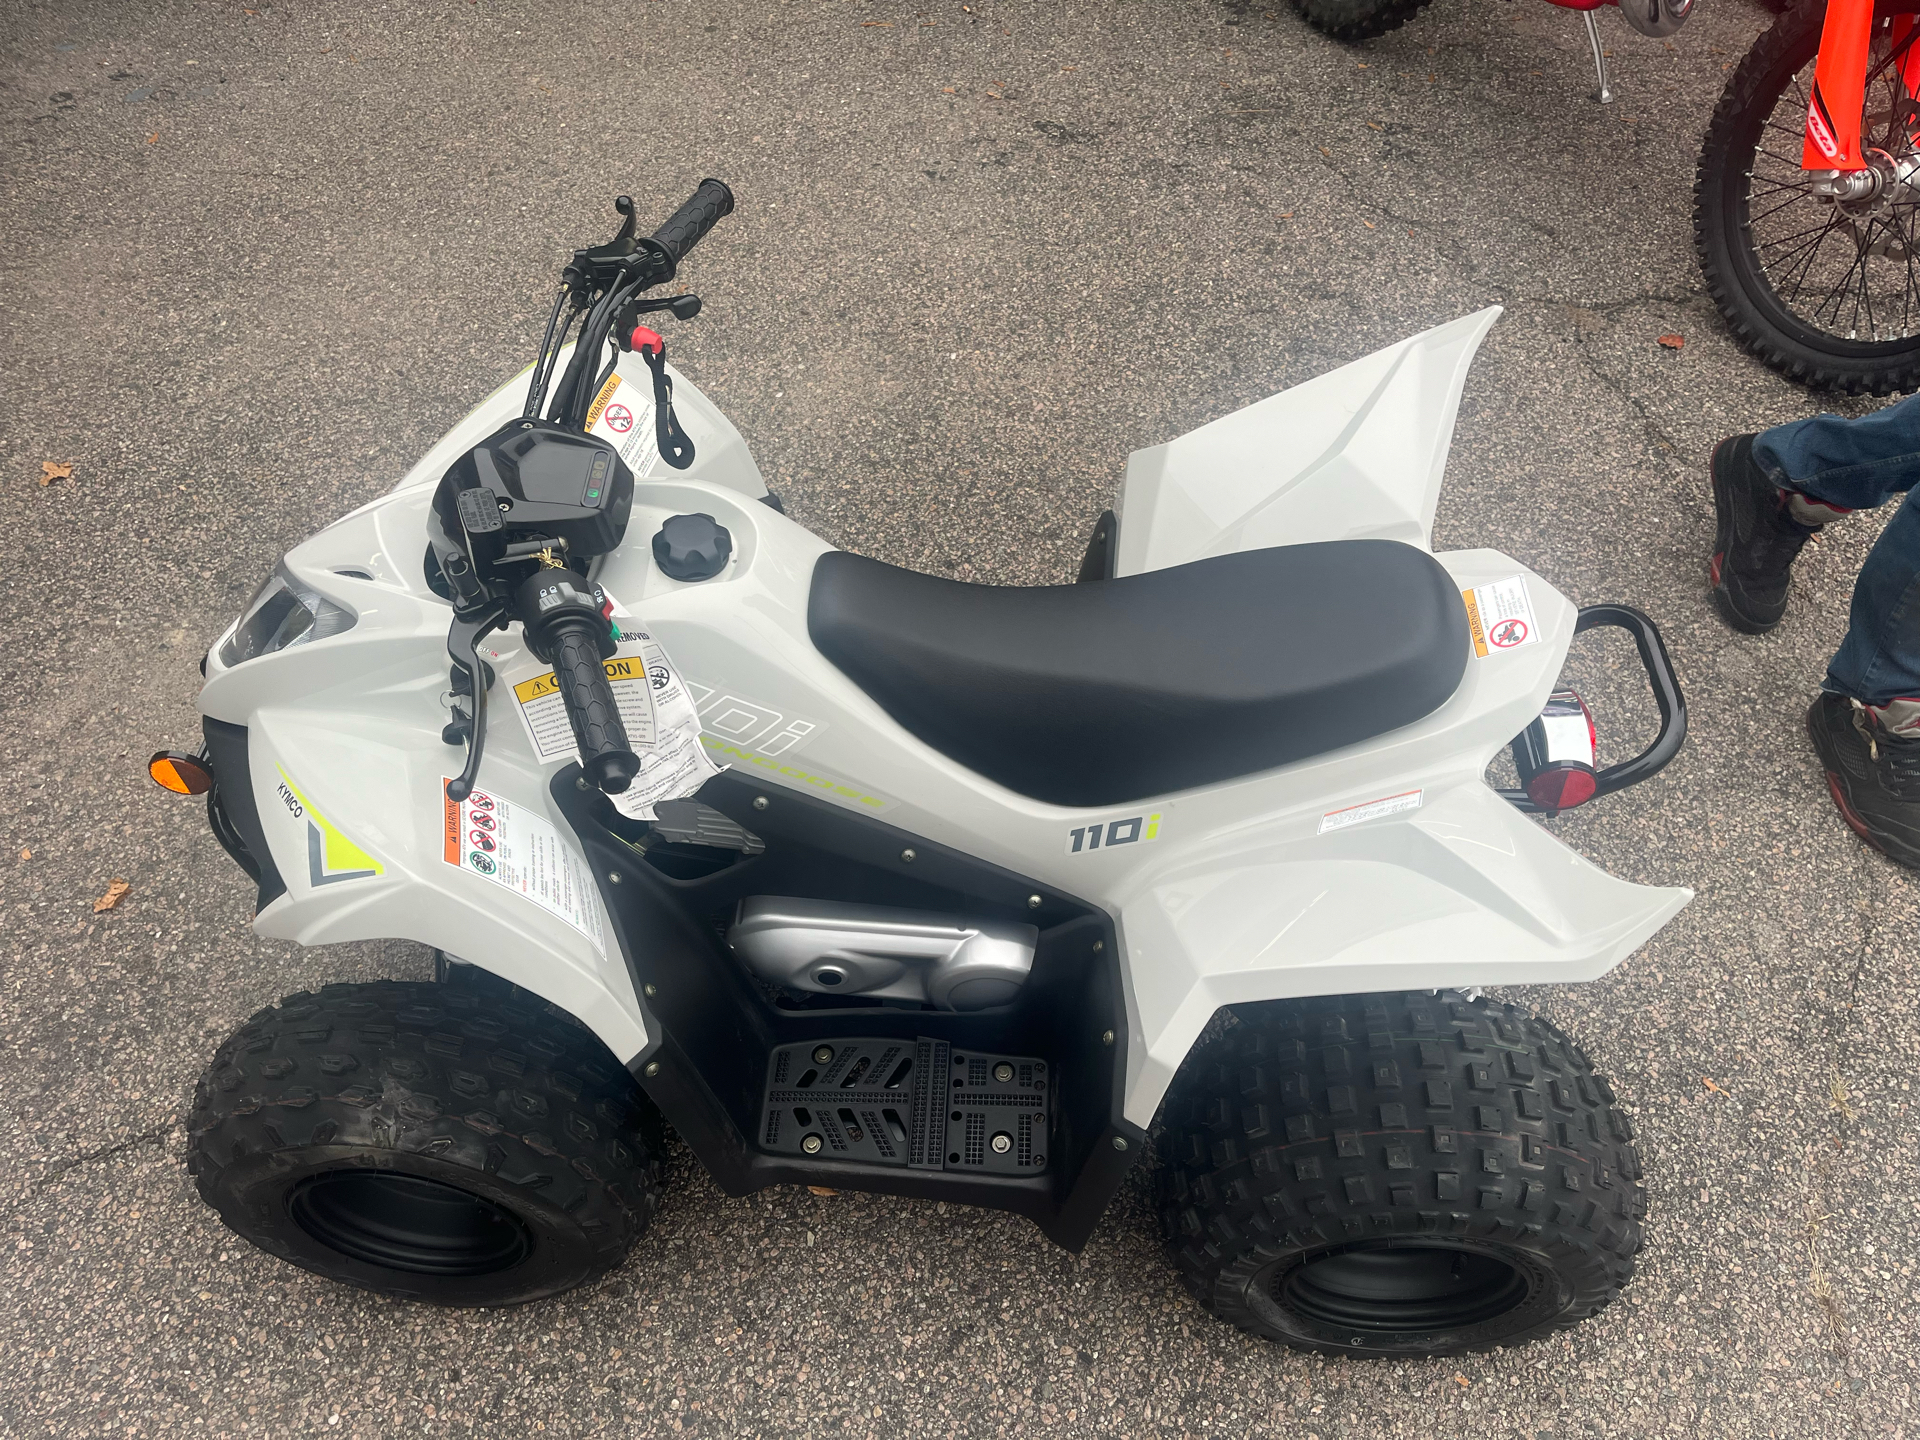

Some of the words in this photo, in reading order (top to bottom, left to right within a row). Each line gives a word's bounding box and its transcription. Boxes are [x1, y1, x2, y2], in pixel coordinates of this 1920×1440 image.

[1810, 117, 1832, 151] Beta
[589, 381, 616, 420] WARNING
[609, 406, 623, 426] UNDER
[621, 417, 632, 430] 12
[1468, 603, 1482, 636] WARNING
[699, 736, 885, 808] ONGOOSE
[277, 782, 302, 818] KYMCO
[1070, 814, 1160, 852] 110i
